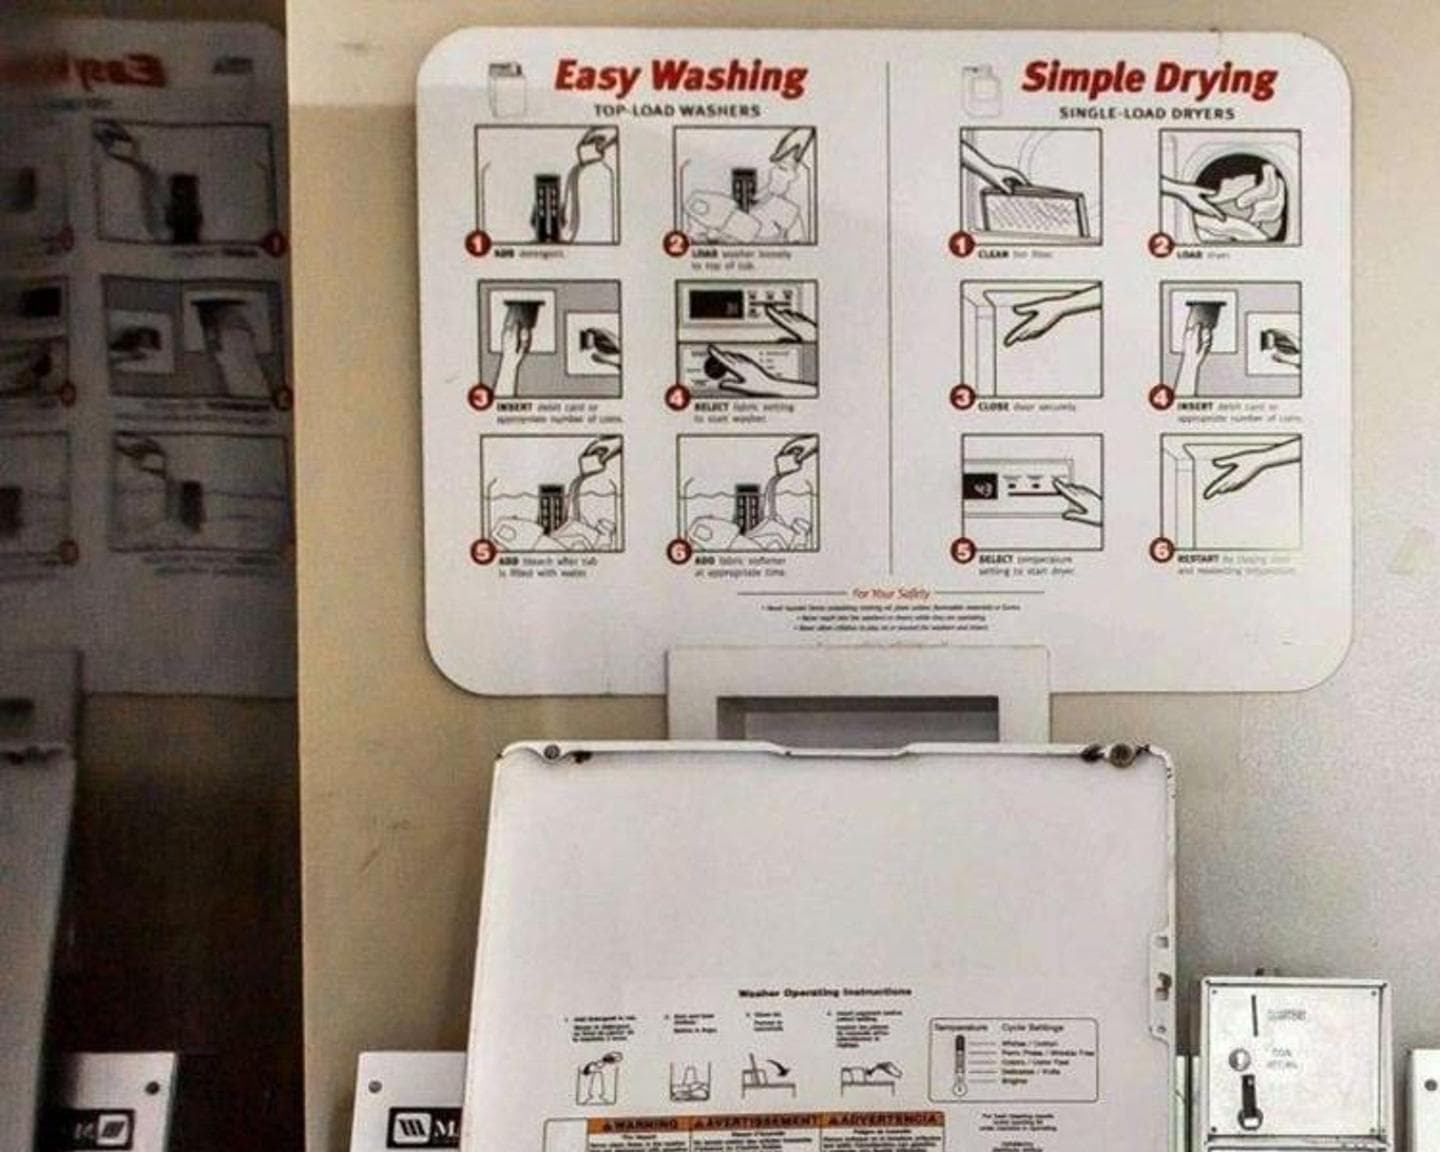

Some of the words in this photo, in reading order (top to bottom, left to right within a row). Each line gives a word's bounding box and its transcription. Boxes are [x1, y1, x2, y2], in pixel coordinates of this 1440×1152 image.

[555, 58, 641, 99] Easy
[652, 58, 808, 99] Washing
[1022, 60, 1145, 100] Simple
[1154, 61, 1278, 101] Drying
[595, 104, 675, 117] TOP-LOAD
[679, 104, 761, 117] WASHERS
[1060, 107, 1166, 120] SINGLE-LOAD
[1171, 107, 1235, 120] DRYERS
[471, 236, 484, 253] 1
[668, 236, 684, 253] 2
[956, 236, 967, 253] 1
[1153, 236, 1170, 254] 2
[473, 388, 486, 407] 3
[669, 388, 684, 407] 4
[955, 388, 971, 407] 3
[1153, 388, 1169, 406] 4
[475, 542, 491, 562] 5
[672, 542, 687, 562] 6
[955, 541, 972, 559] 5
[852, 588, 870, 600] For
[872, 588, 896, 600] Your
[897, 587, 931, 601] Safety
[738, 988, 780, 998] Washer
[784, 987, 839, 999] Operating
[843, 987, 912, 997] Instructions
[614, 1119, 678, 1132] WARNING
[707, 1115, 818, 1131] AVERTISSEMENT
[842, 1112, 938, 1127] ADVERTENCIA
